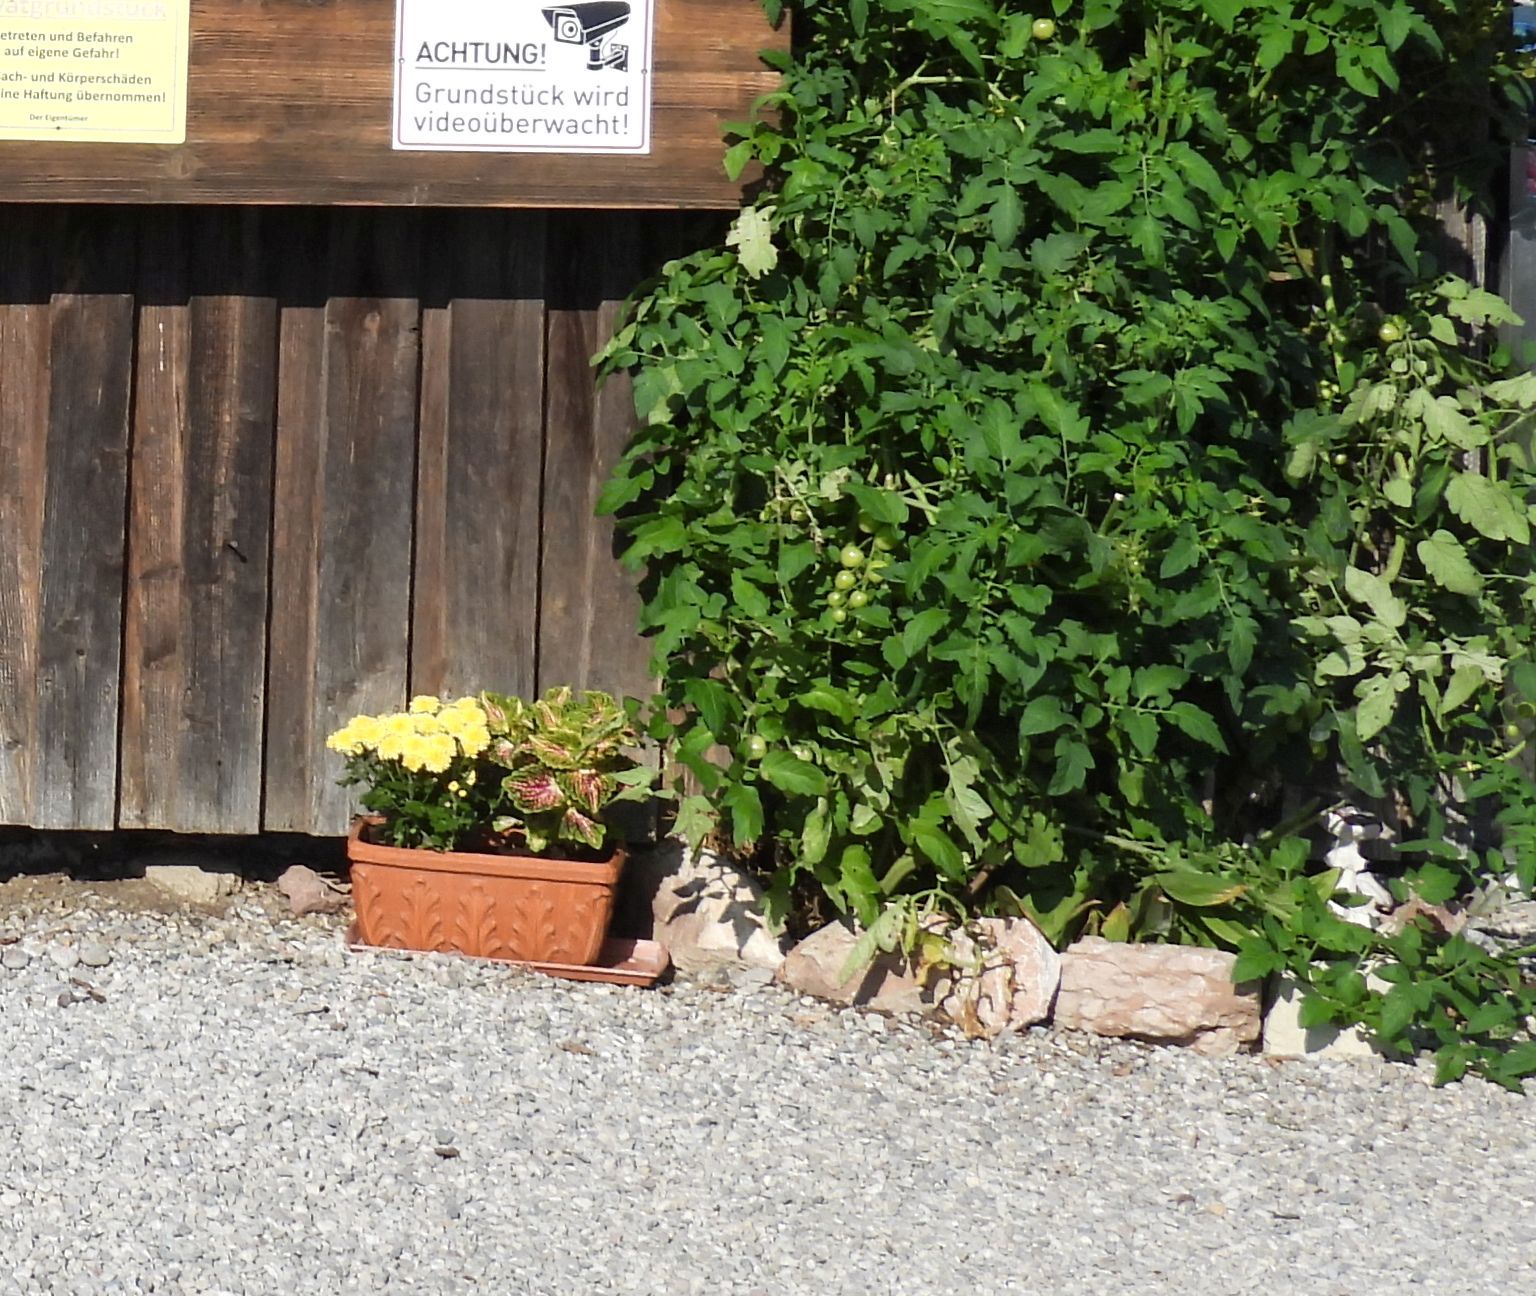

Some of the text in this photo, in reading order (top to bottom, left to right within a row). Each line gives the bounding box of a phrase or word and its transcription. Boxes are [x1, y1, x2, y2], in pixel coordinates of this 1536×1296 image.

[49, 30, 74, 42] und
[77, 31, 134, 44] Befahren
[4, 45, 120, 59] auf eigene Gefahr!
[415, 41, 547, 65] ACHTUNG!
[31, 71, 55, 83] und
[58, 71, 152, 86] Körperschäden
[23, 88, 73, 103] Haftung
[76, 89, 166, 103] übernommen!
[415, 82, 629, 107] Grundstück wird
[29, 113, 43, 122] Der
[414, 111, 629, 136] videoüberwacht!
